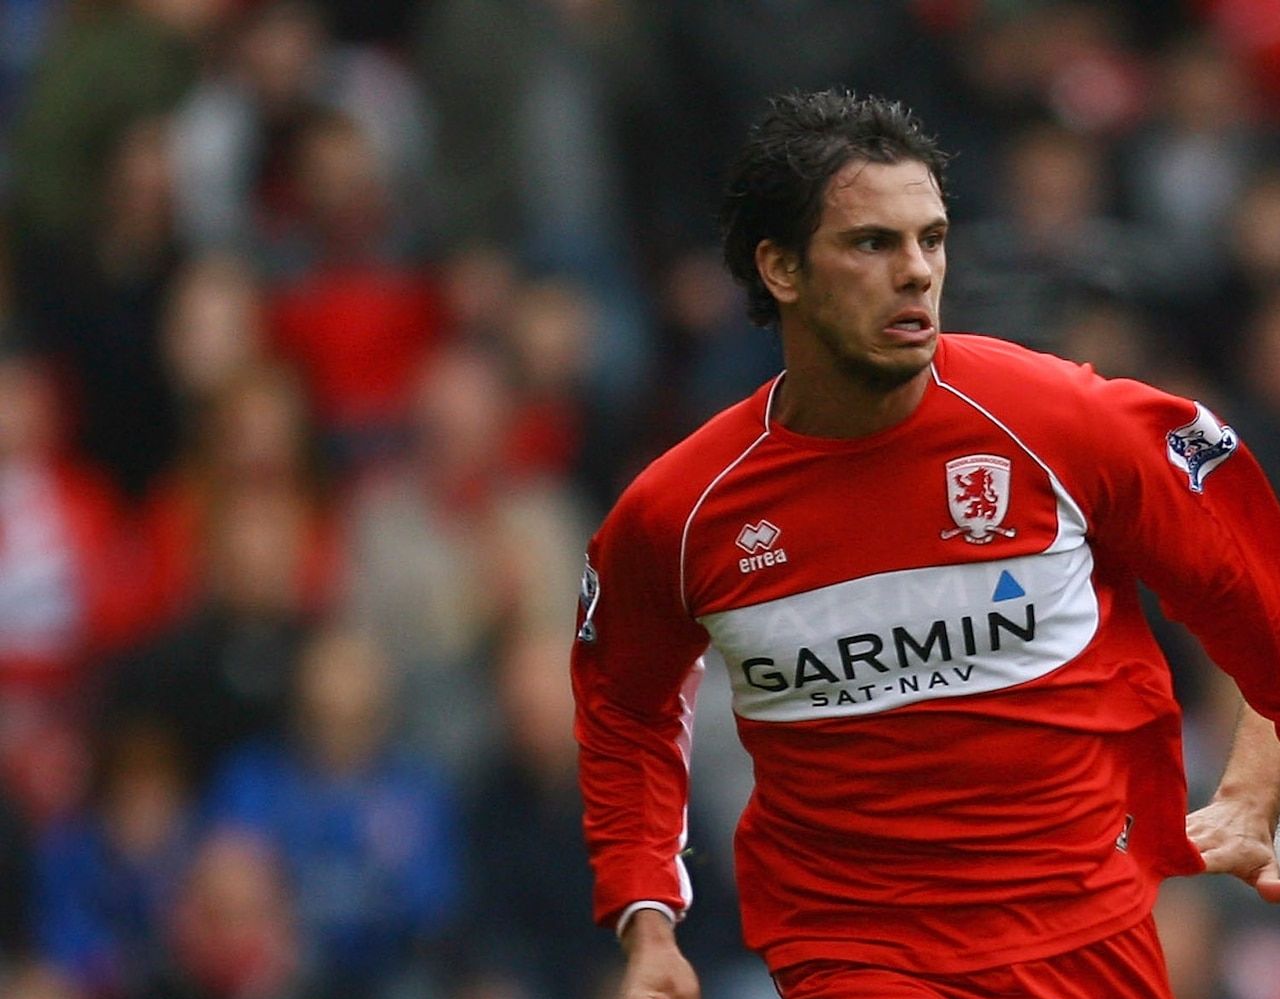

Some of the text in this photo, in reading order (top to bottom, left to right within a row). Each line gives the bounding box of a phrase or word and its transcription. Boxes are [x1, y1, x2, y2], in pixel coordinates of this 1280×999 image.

[739, 548, 787, 573] errea
[740, 603, 1035, 692] GARMIN
[811, 664, 974, 707] SAT-NAV
